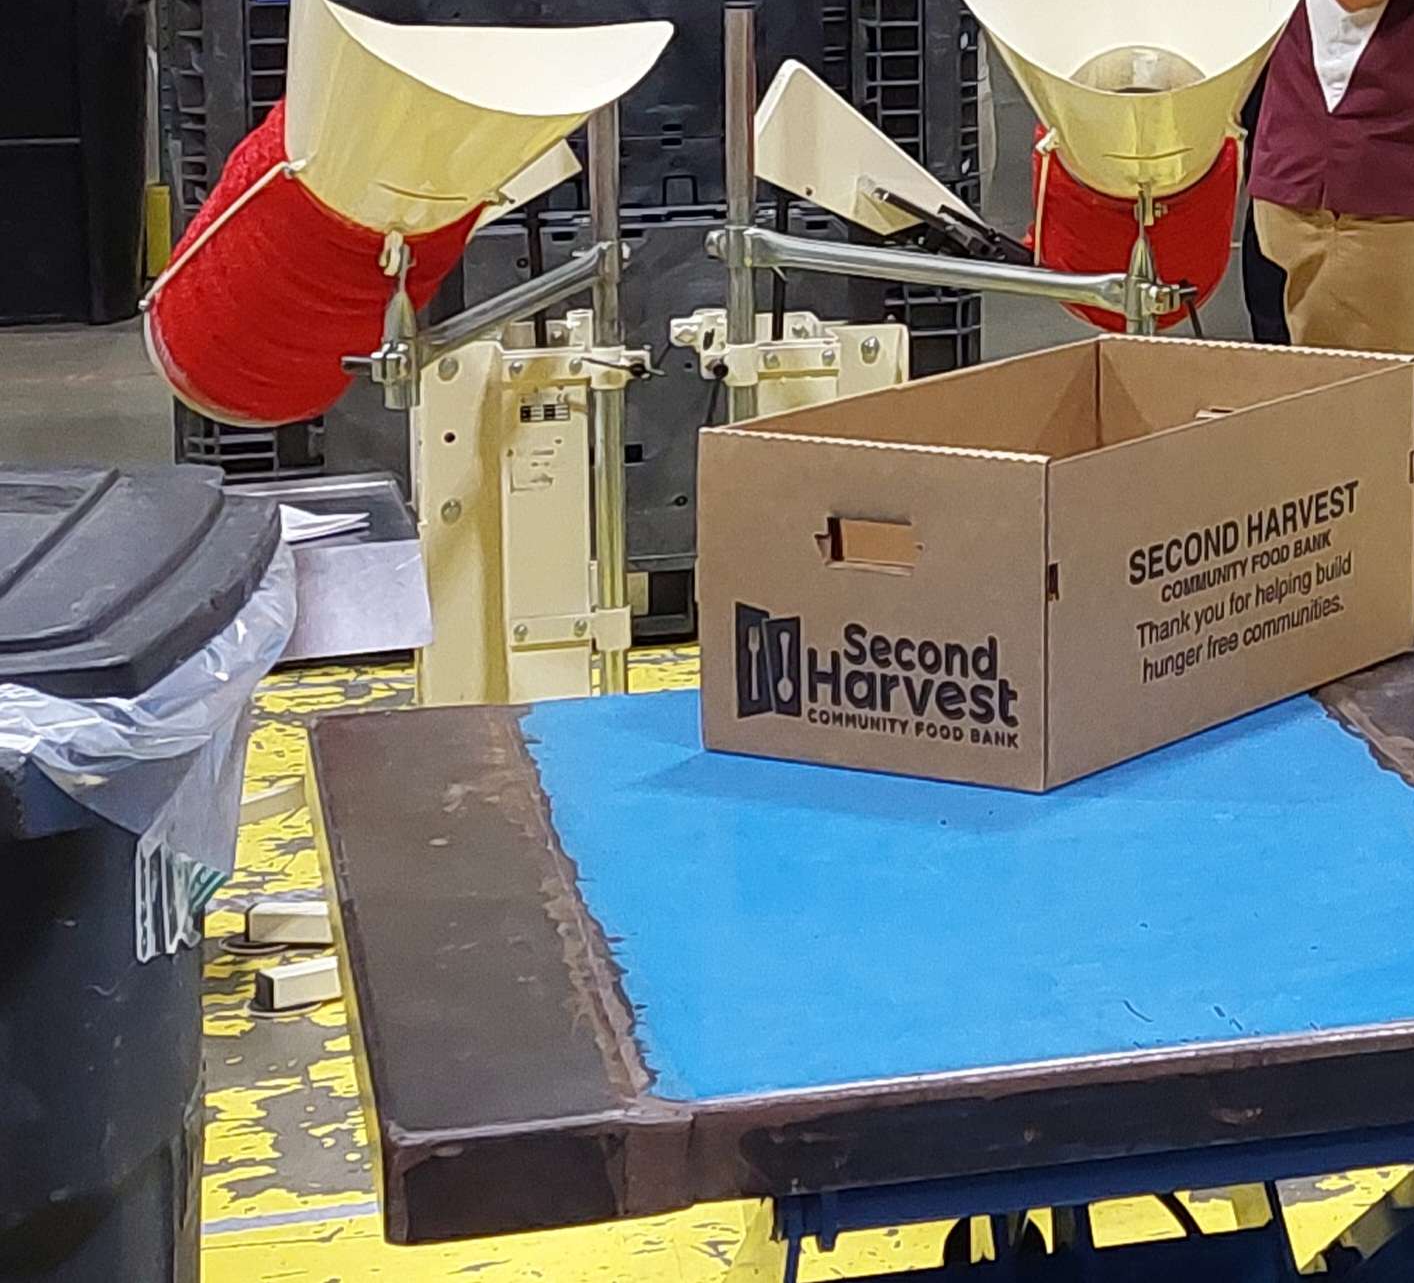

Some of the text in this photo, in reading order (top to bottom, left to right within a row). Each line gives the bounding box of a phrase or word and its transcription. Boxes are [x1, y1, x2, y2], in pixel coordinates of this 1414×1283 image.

[1129, 480, 1359, 585] SECOND HARVEST
[1161, 528, 1332, 603] COMMUNITY FOOD BANK
[1136, 551, 1352, 649] Thank you for helping build
[1142, 593, 1345, 684] hunger free communities.
[806, 647, 1019, 728] Harvest
[843, 623, 998, 680] Second
[807, 707, 1020, 750] COMMUNITY FOOD BANK
